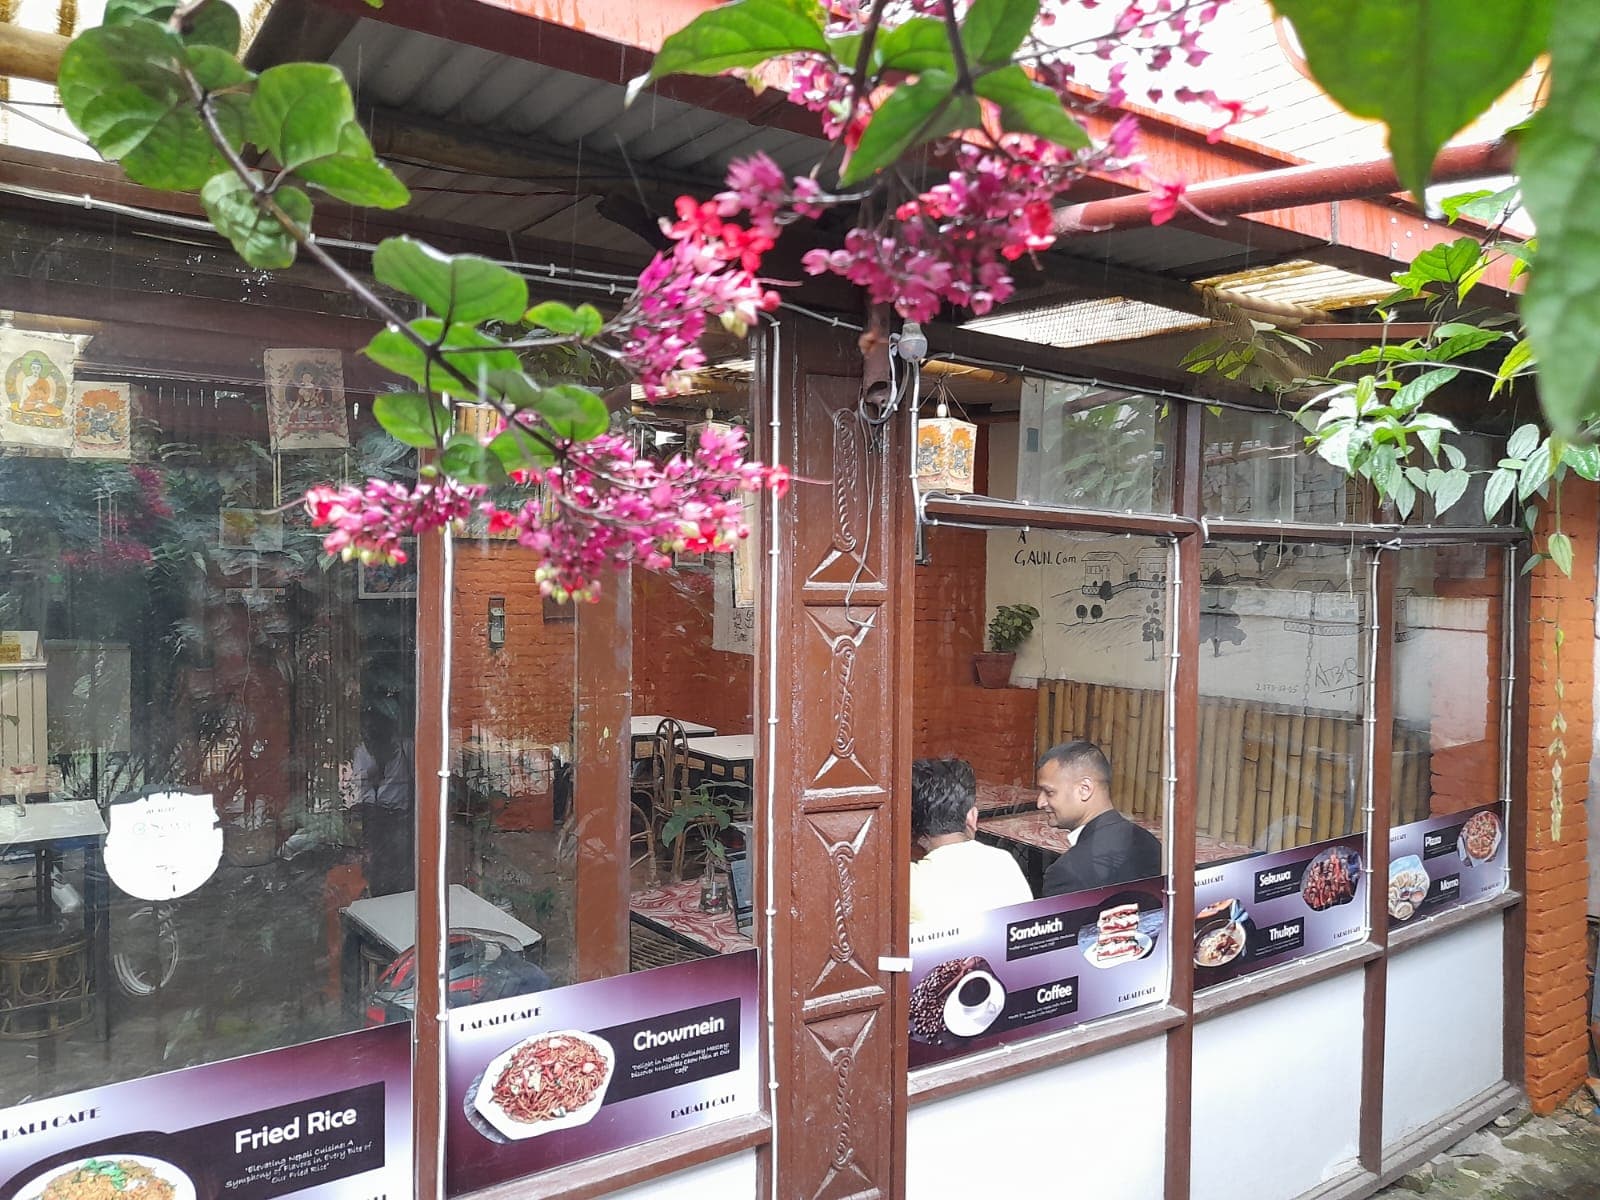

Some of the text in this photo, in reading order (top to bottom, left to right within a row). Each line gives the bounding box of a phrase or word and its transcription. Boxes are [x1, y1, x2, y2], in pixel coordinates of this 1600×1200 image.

[1259, 870, 1291, 887] Sekuwa
[1010, 917, 1063, 942] Sandwich
[1269, 924, 1300, 941] Thukpa
[1037, 984, 1073, 1004] Coffee
[633, 1016, 725, 1051] Chowmein
[52, 1105, 102, 1128] CAFE
[235, 1108, 357, 1154] Fried Rice
[288, 1149, 313, 1162] Nepali
[224, 1170, 272, 1190] Symphony
[313, 1156, 323, 1165] in
[324, 1150, 346, 1161] Every
[271, 1175, 287, 1185] Our
[289, 1166, 309, 1179] Fried
